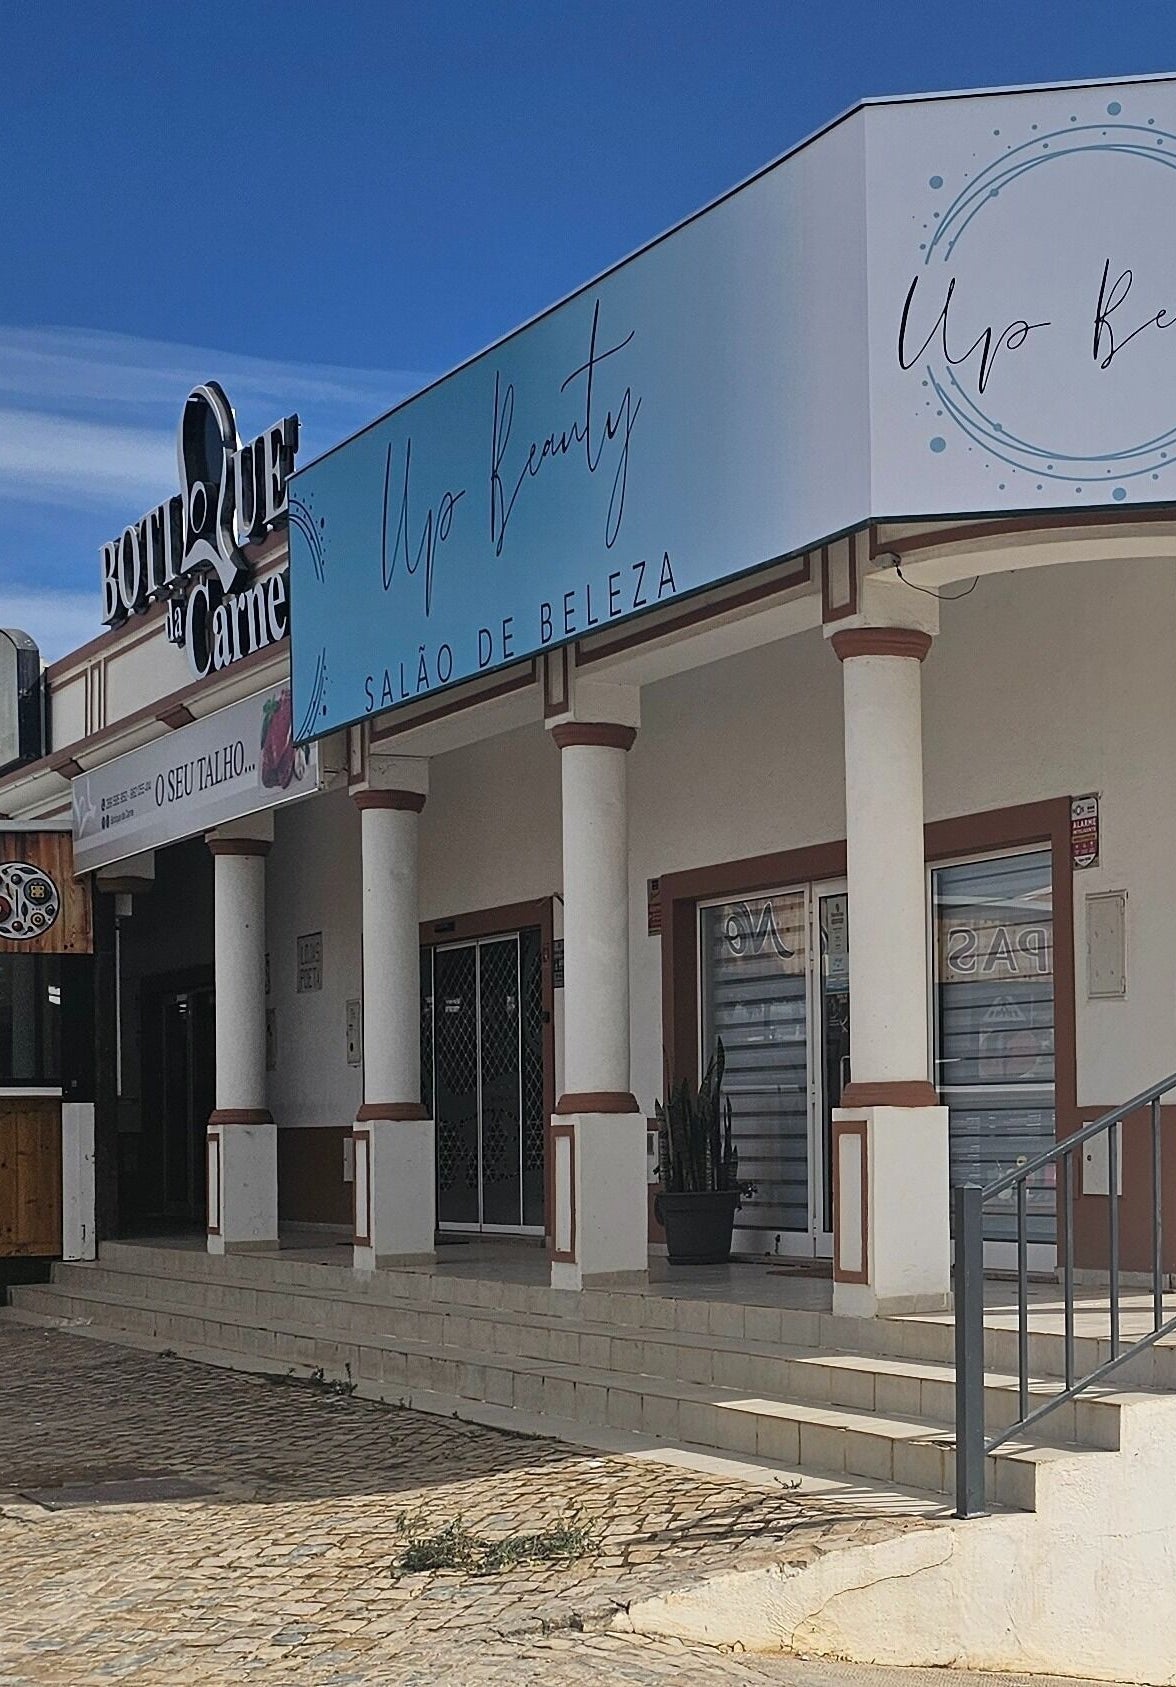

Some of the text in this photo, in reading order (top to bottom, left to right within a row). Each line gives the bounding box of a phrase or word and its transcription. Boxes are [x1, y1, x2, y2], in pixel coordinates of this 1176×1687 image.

[900, 275, 1051, 393] Up
[382, 299, 642, 617] Up Beauty
[165, 572, 288, 680] da Carne
[364, 551, 677, 713] SALÃO DE BELEZA
[155, 774, 165, 806] O
[168, 761, 194, 802] SEU
